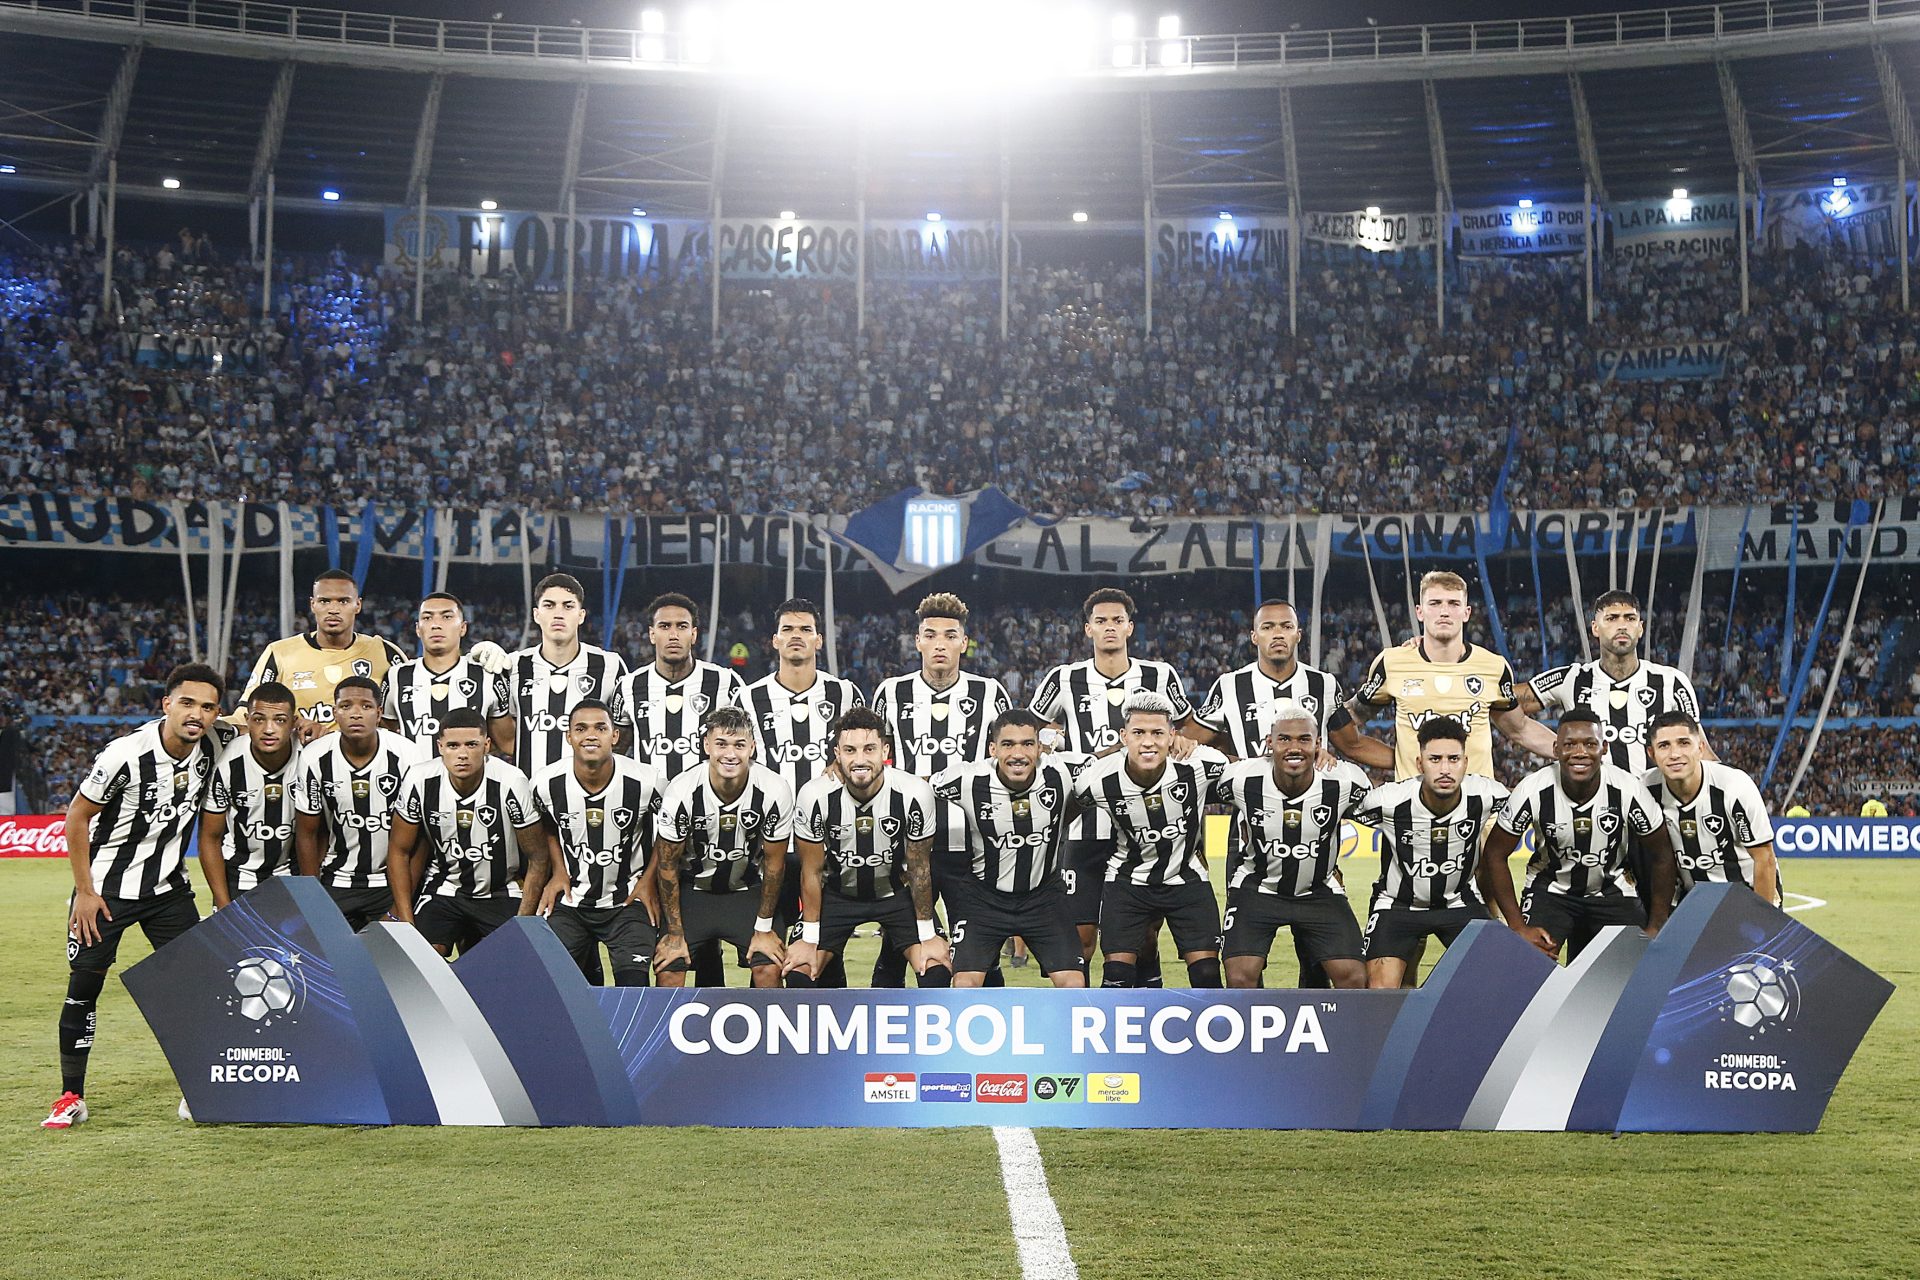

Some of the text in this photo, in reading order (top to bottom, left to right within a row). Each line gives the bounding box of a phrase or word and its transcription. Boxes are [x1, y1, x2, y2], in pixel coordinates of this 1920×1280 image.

[1463, 210, 1584, 230] GRACIAS VIEJO POR
[1619, 210, 1641, 229] LA
[720, 224, 858, 274] CASEROS
[1480, 235, 1532, 251] HERENCIA
[1538, 233, 1563, 247] MAS
[1614, 240, 1658, 260] ESDE
[909, 503, 958, 513] RACING
[1341, 507, 1680, 554] ZONA NORTE
[1741, 527, 1920, 562] MAND
[1034, 681, 1056, 711] Centrum
[524, 709, 571, 732] vbe
[1600, 719, 1648, 745] bet
[641, 732, 701, 756] vbet
[769, 738, 830, 764] vbet
[905, 732, 968, 756] vbet
[239, 820, 296, 842] vbe
[333, 810, 392, 833] vbet
[1128, 817, 1188, 845] vbet
[986, 825, 1053, 850] vbet
[1257, 838, 1321, 860] vbet
[434, 837, 496, 862] vbet
[567, 842, 623, 868] vbet
[831, 848, 894, 868] vbet
[1551, 844, 1610, 868] vbet
[1676, 848, 1725, 871] bet
[1402, 853, 1467, 879] vbet
[668, 1002, 1046, 1057] CONMEBOL
[1070, 1003, 1330, 1055] RECOPA
[226, 1047, 286, 1062] CONMEBOL
[1719, 1053, 1781, 1070] CONMEBOL
[210, 1065, 301, 1083] RECOPA
[1704, 1070, 1798, 1091] RECOPA
[870, 1089, 911, 1100] AMSTEL
[920, 1083, 971, 1093] sportingbet
[959, 1091, 971, 1099] tv
[977, 1079, 1026, 1098] Coca-Cola
[1098, 1088, 1130, 1097] mercado
